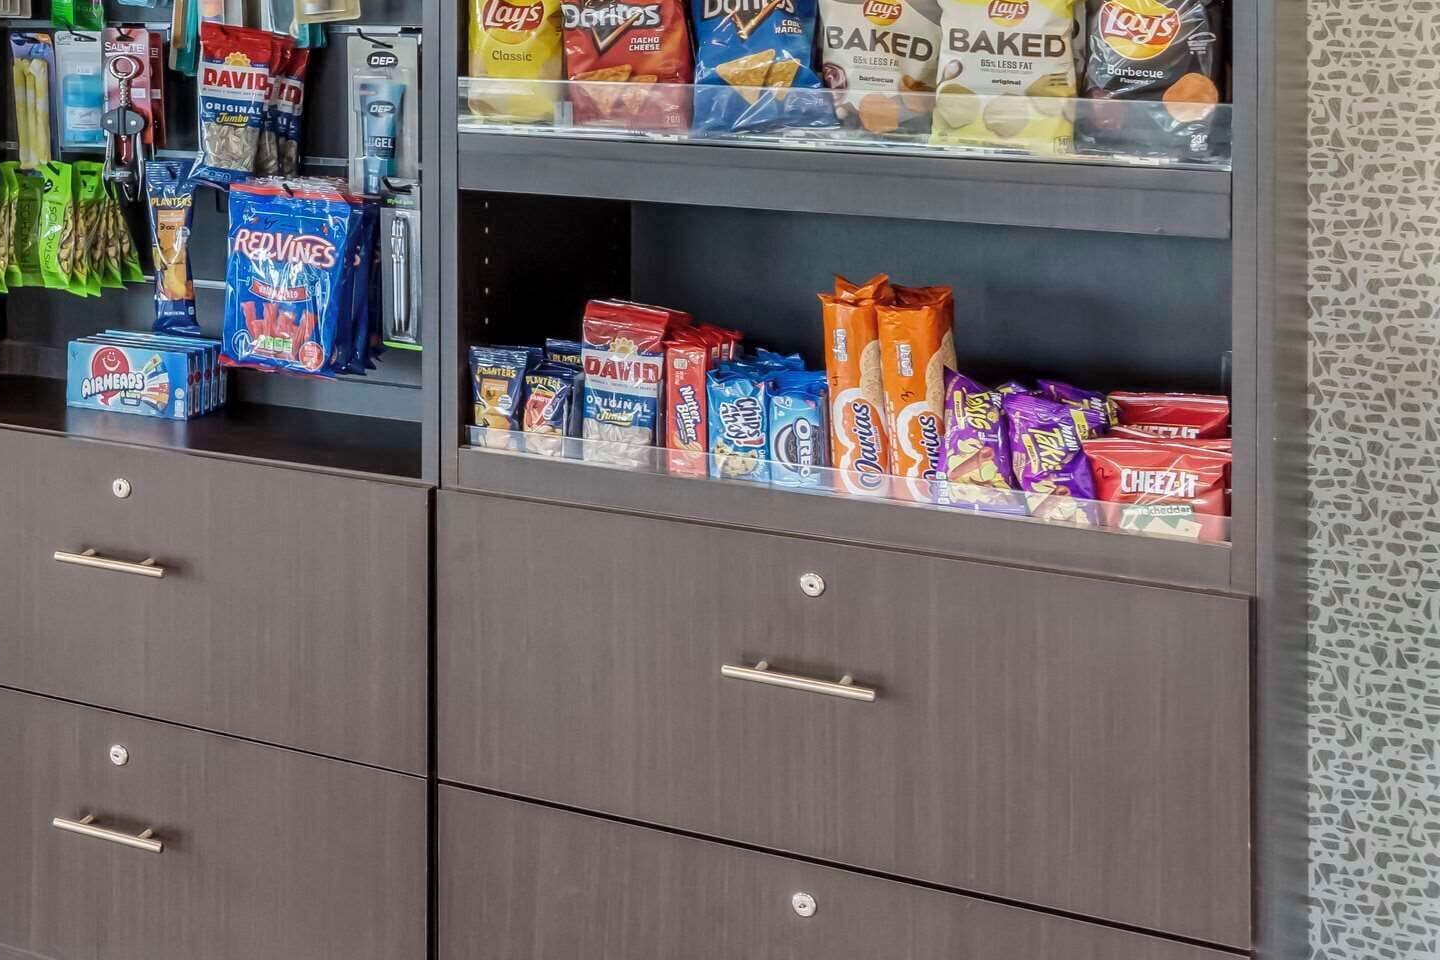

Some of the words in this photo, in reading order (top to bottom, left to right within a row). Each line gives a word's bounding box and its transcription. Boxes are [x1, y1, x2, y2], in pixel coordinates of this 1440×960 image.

[485, 0, 541, 32] Lay's
[562, 3, 661, 29] Doritos
[864, 0, 901, 20] Lay's
[988, 0, 1028, 20] Lay's
[1103, 5, 1181, 45] Lay's
[630, 36, 660, 45] NACHO
[826, 25, 933, 62] BAKED
[949, 28, 1067, 58] BAKED
[371, 56, 394, 66] DEP
[492, 50, 532, 62] Classic
[869, 56, 889, 67] LESS
[997, 60, 1015, 70] LESS
[1016, 61, 1033, 71] FAT
[203, 68, 268, 90] DAVID
[1106, 65, 1164, 79] Barbecue
[205, 102, 261, 115] ORIGINAL
[216, 112, 249, 124] Jumbo
[370, 104, 393, 113] DEP
[151, 197, 192, 207] PLANTERS
[583, 355, 661, 384] DAVID
[81, 372, 145, 399] AIRHEADS
[679, 385, 701, 423] Nutter
[676, 404, 698, 441] Butter
[794, 418, 812, 477] OREO
[1120, 468, 1199, 498] CHEEZ-IT
